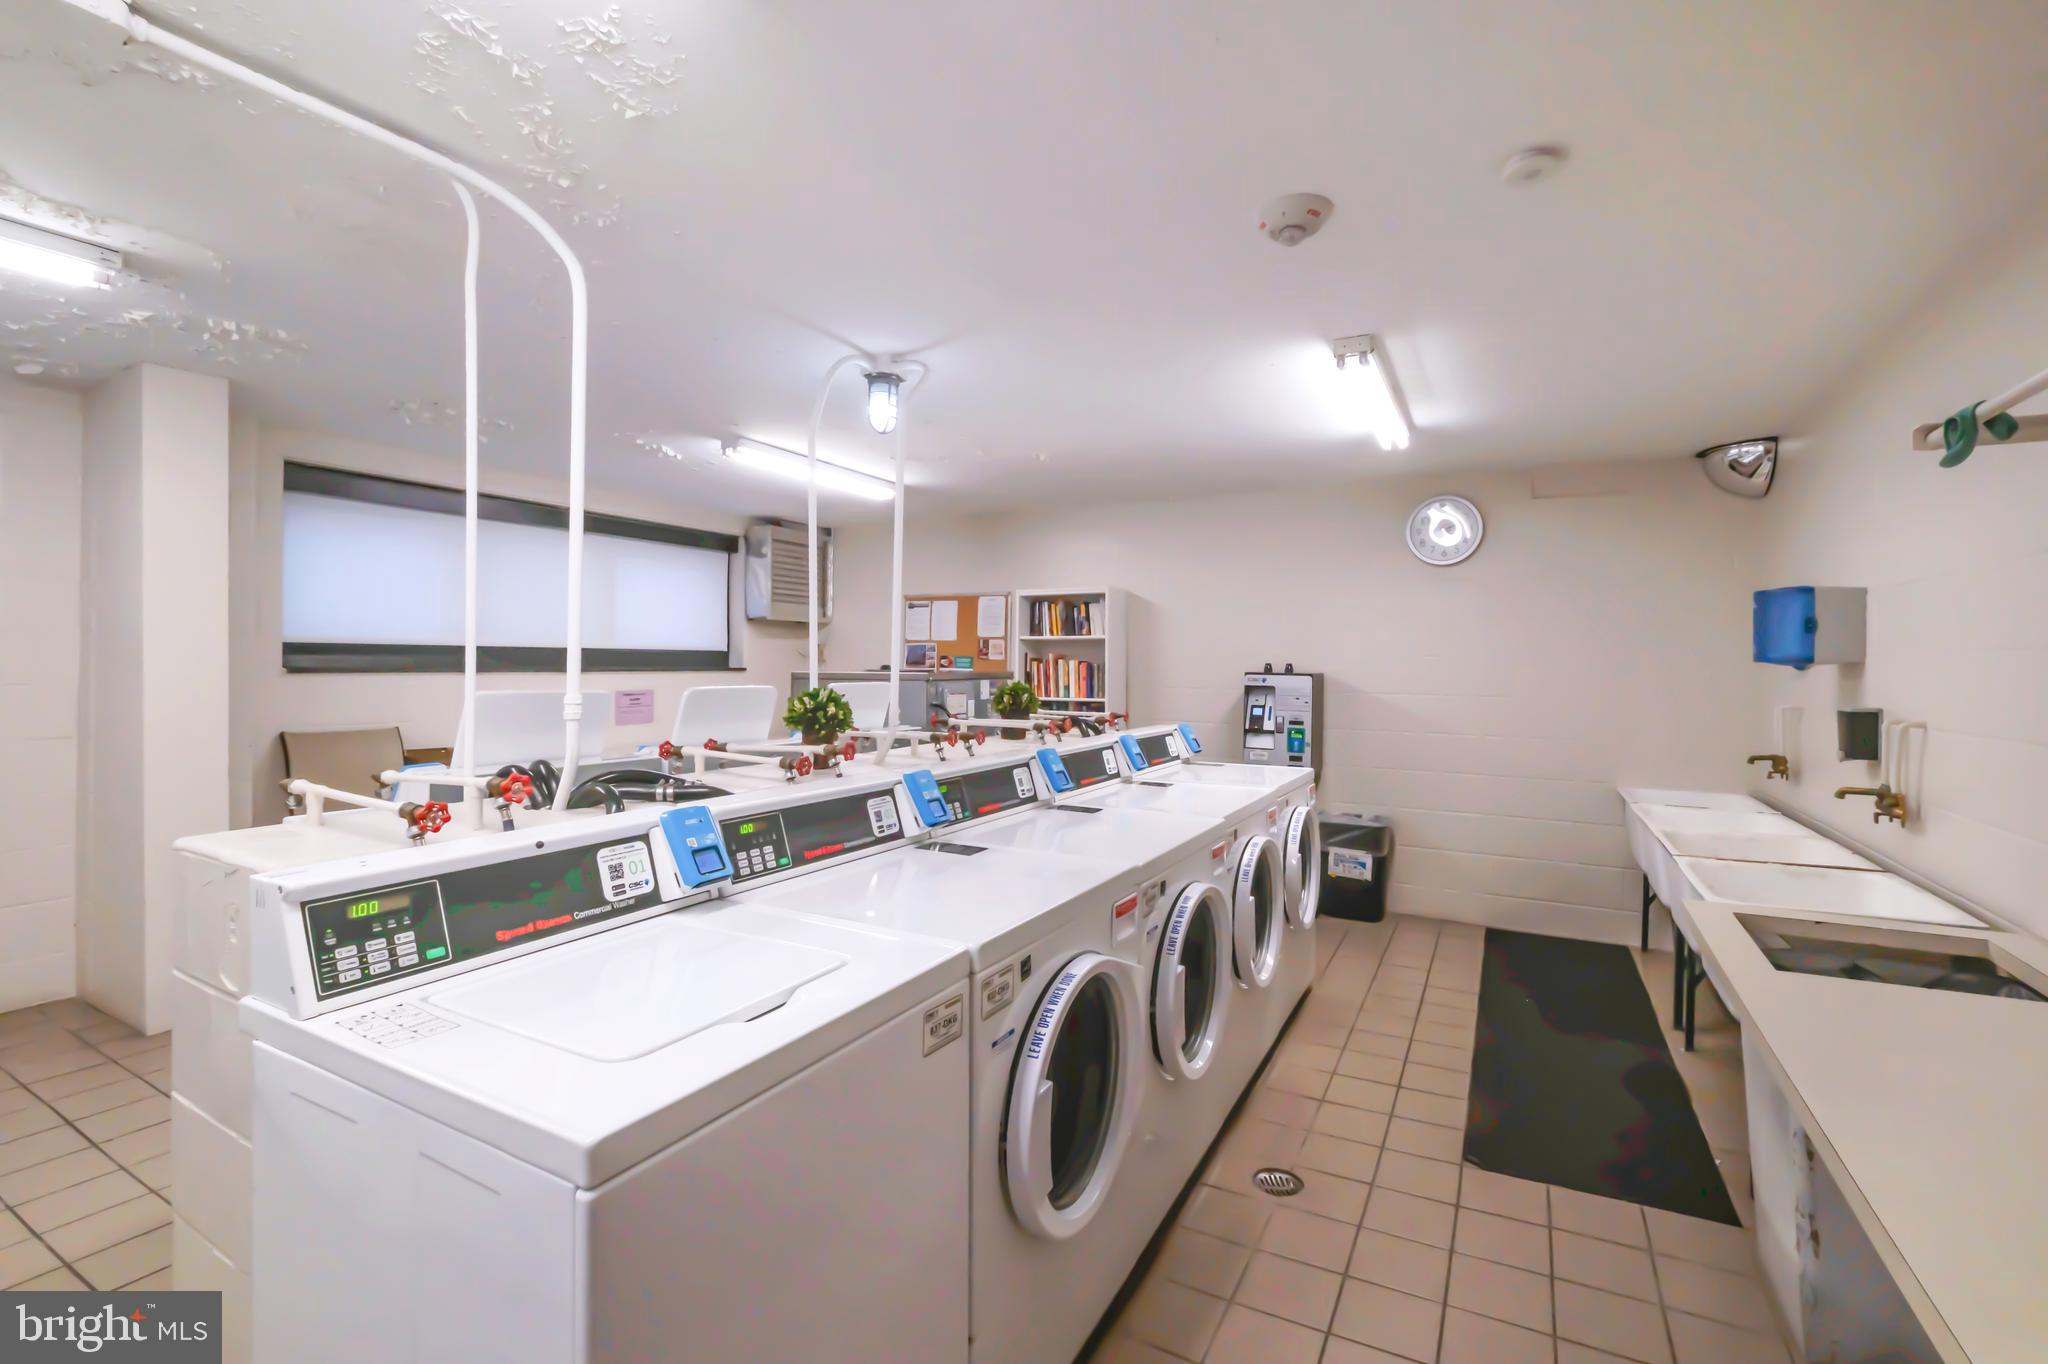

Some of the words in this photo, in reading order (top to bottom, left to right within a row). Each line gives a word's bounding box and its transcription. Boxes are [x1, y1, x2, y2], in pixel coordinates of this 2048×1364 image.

[628, 859, 647, 876] 01
[1170, 920, 1183, 935] OPEN
[1166, 936, 1179, 956] LEAVE
[1027, 1030, 1047, 1060] LEAVE
[1037, 1007, 1056, 1029] OPEN
[1047, 986, 1067, 1006] WHEN
